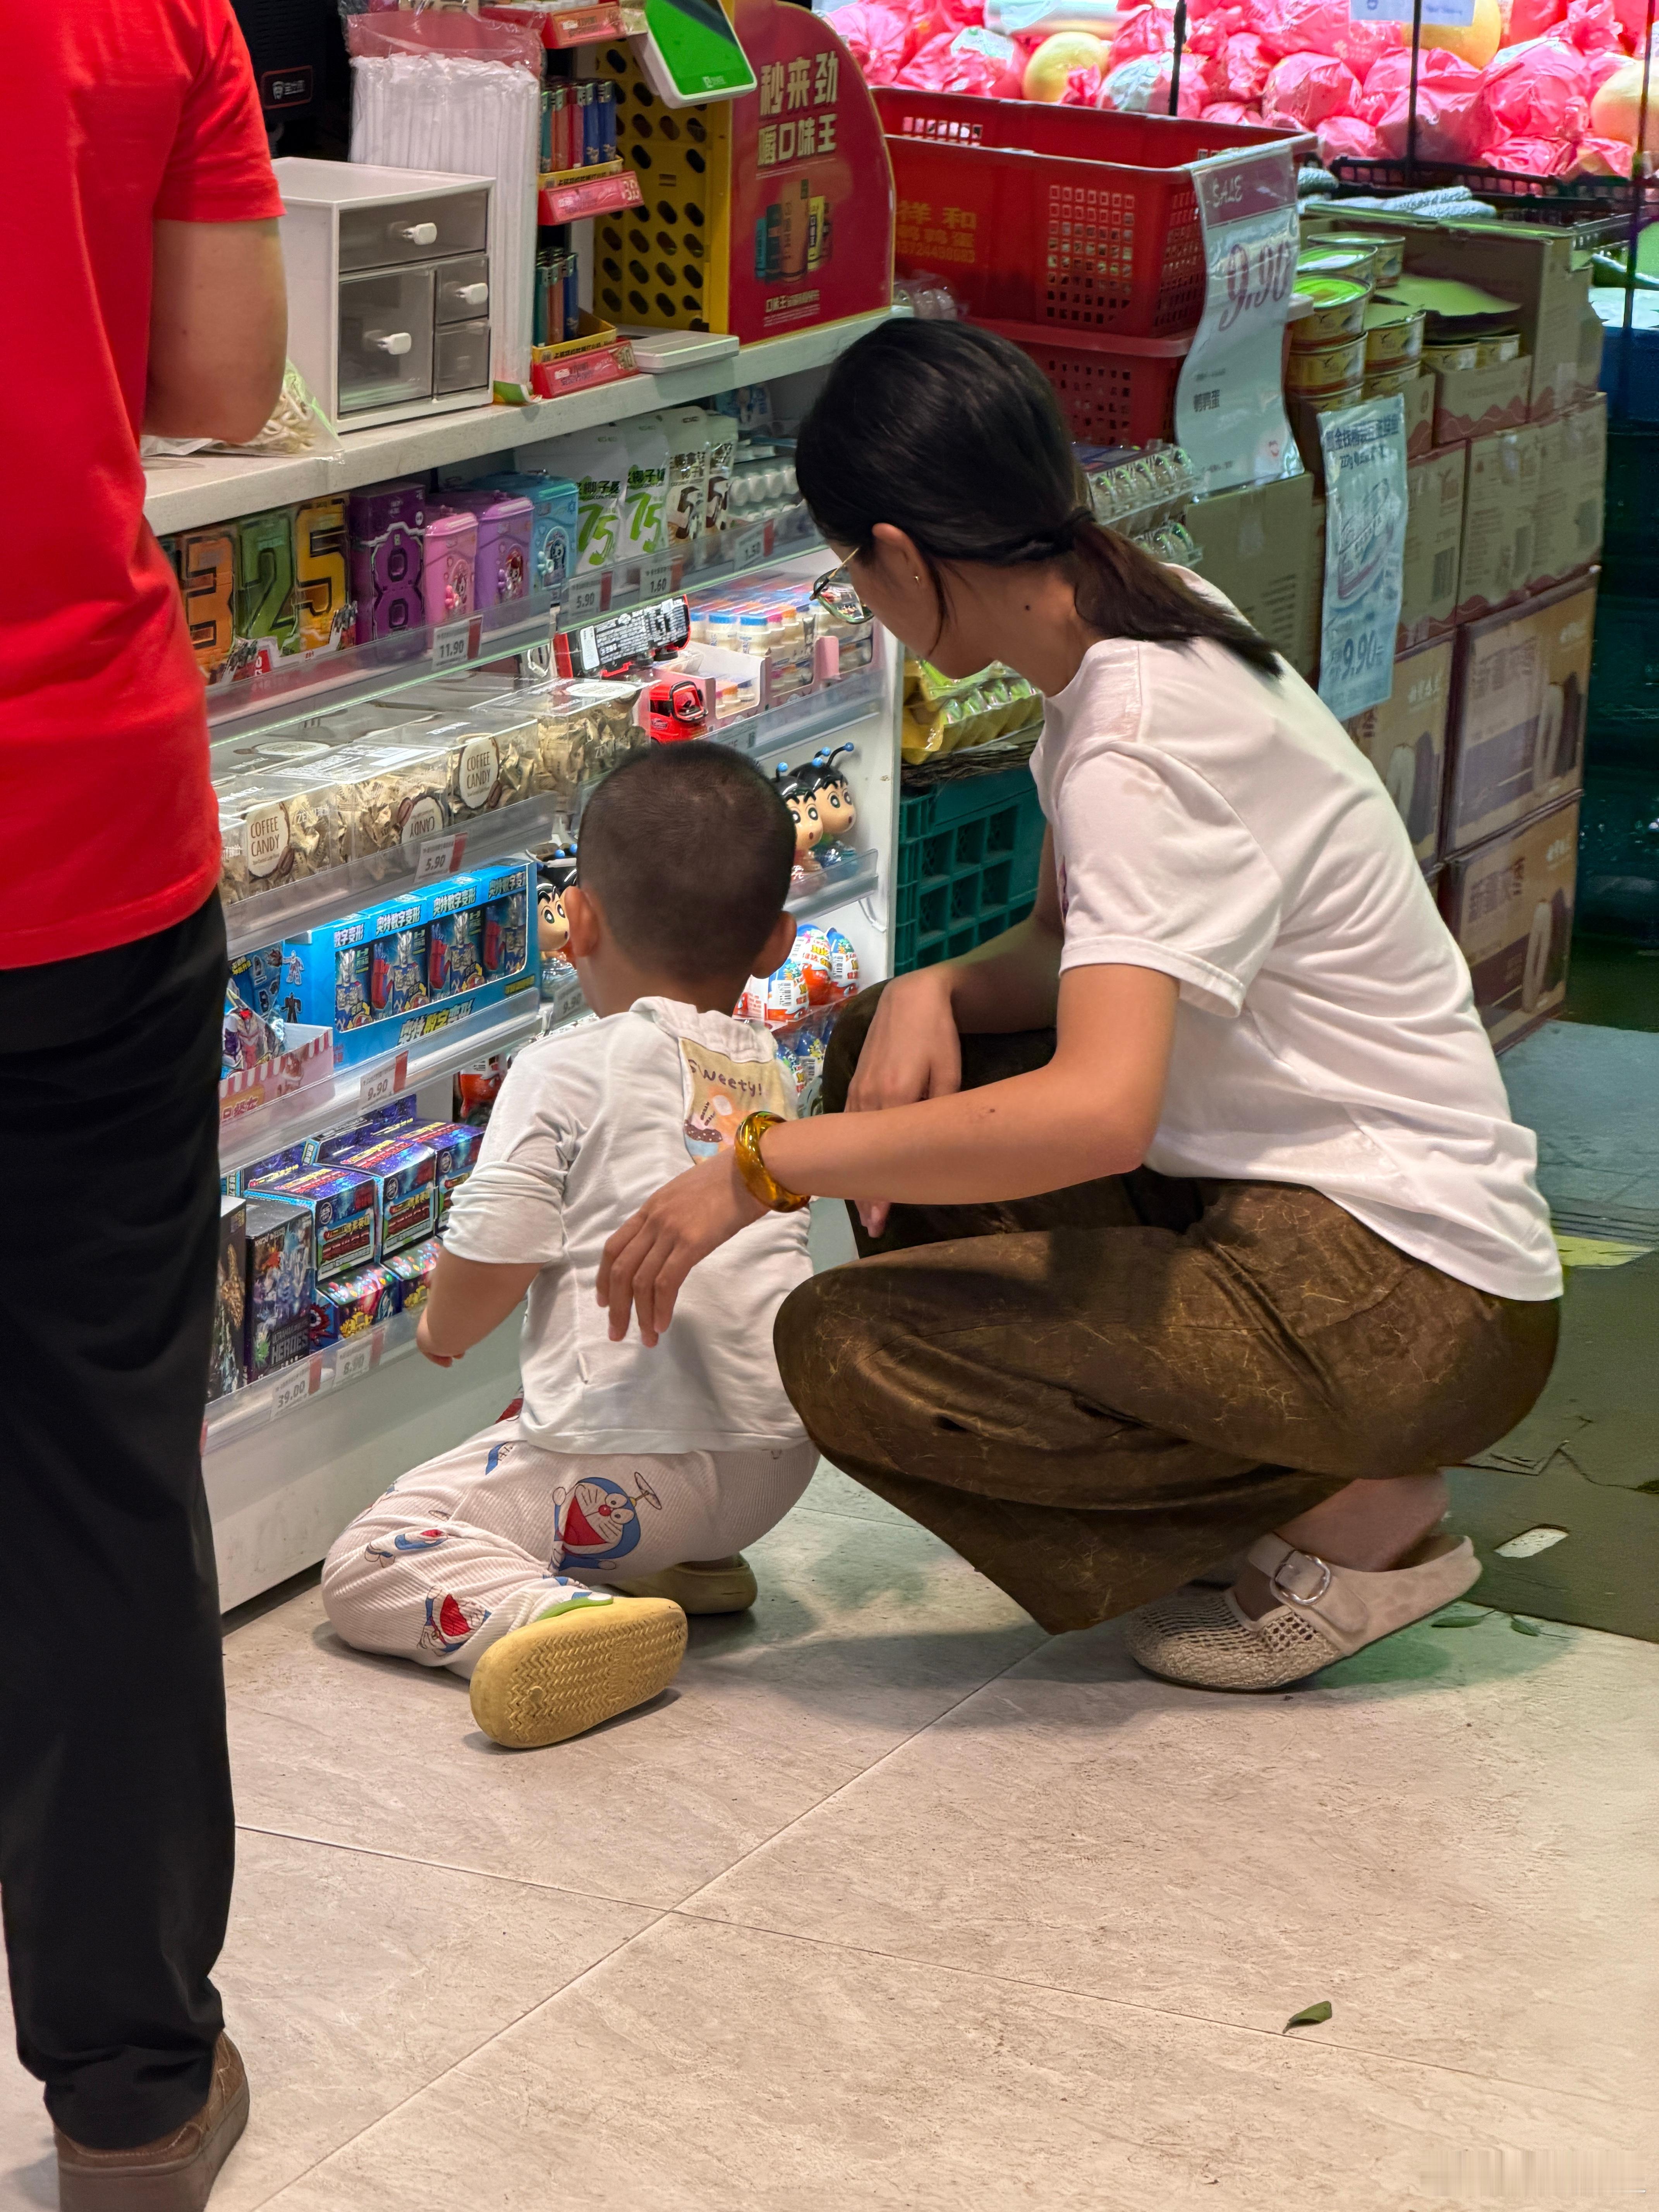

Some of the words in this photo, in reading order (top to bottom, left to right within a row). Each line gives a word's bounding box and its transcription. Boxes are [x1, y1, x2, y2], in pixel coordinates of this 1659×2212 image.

[576, 592, 595, 609] 5.90
[440, 639, 464, 658] 11.90
[467, 751, 491, 771] COFFEE
[467, 768, 491, 789] CANDY
[251, 816, 279, 838] COFFEE
[409, 816, 435, 838] CANDY
[251, 834, 280, 857] CANDY
[425, 854, 446, 871] 5.90
[375, 904, 422, 937] 奥特数字变形
[368, 1079, 388, 1101] 9.90
[278, 1380, 305, 1408] 39.00
